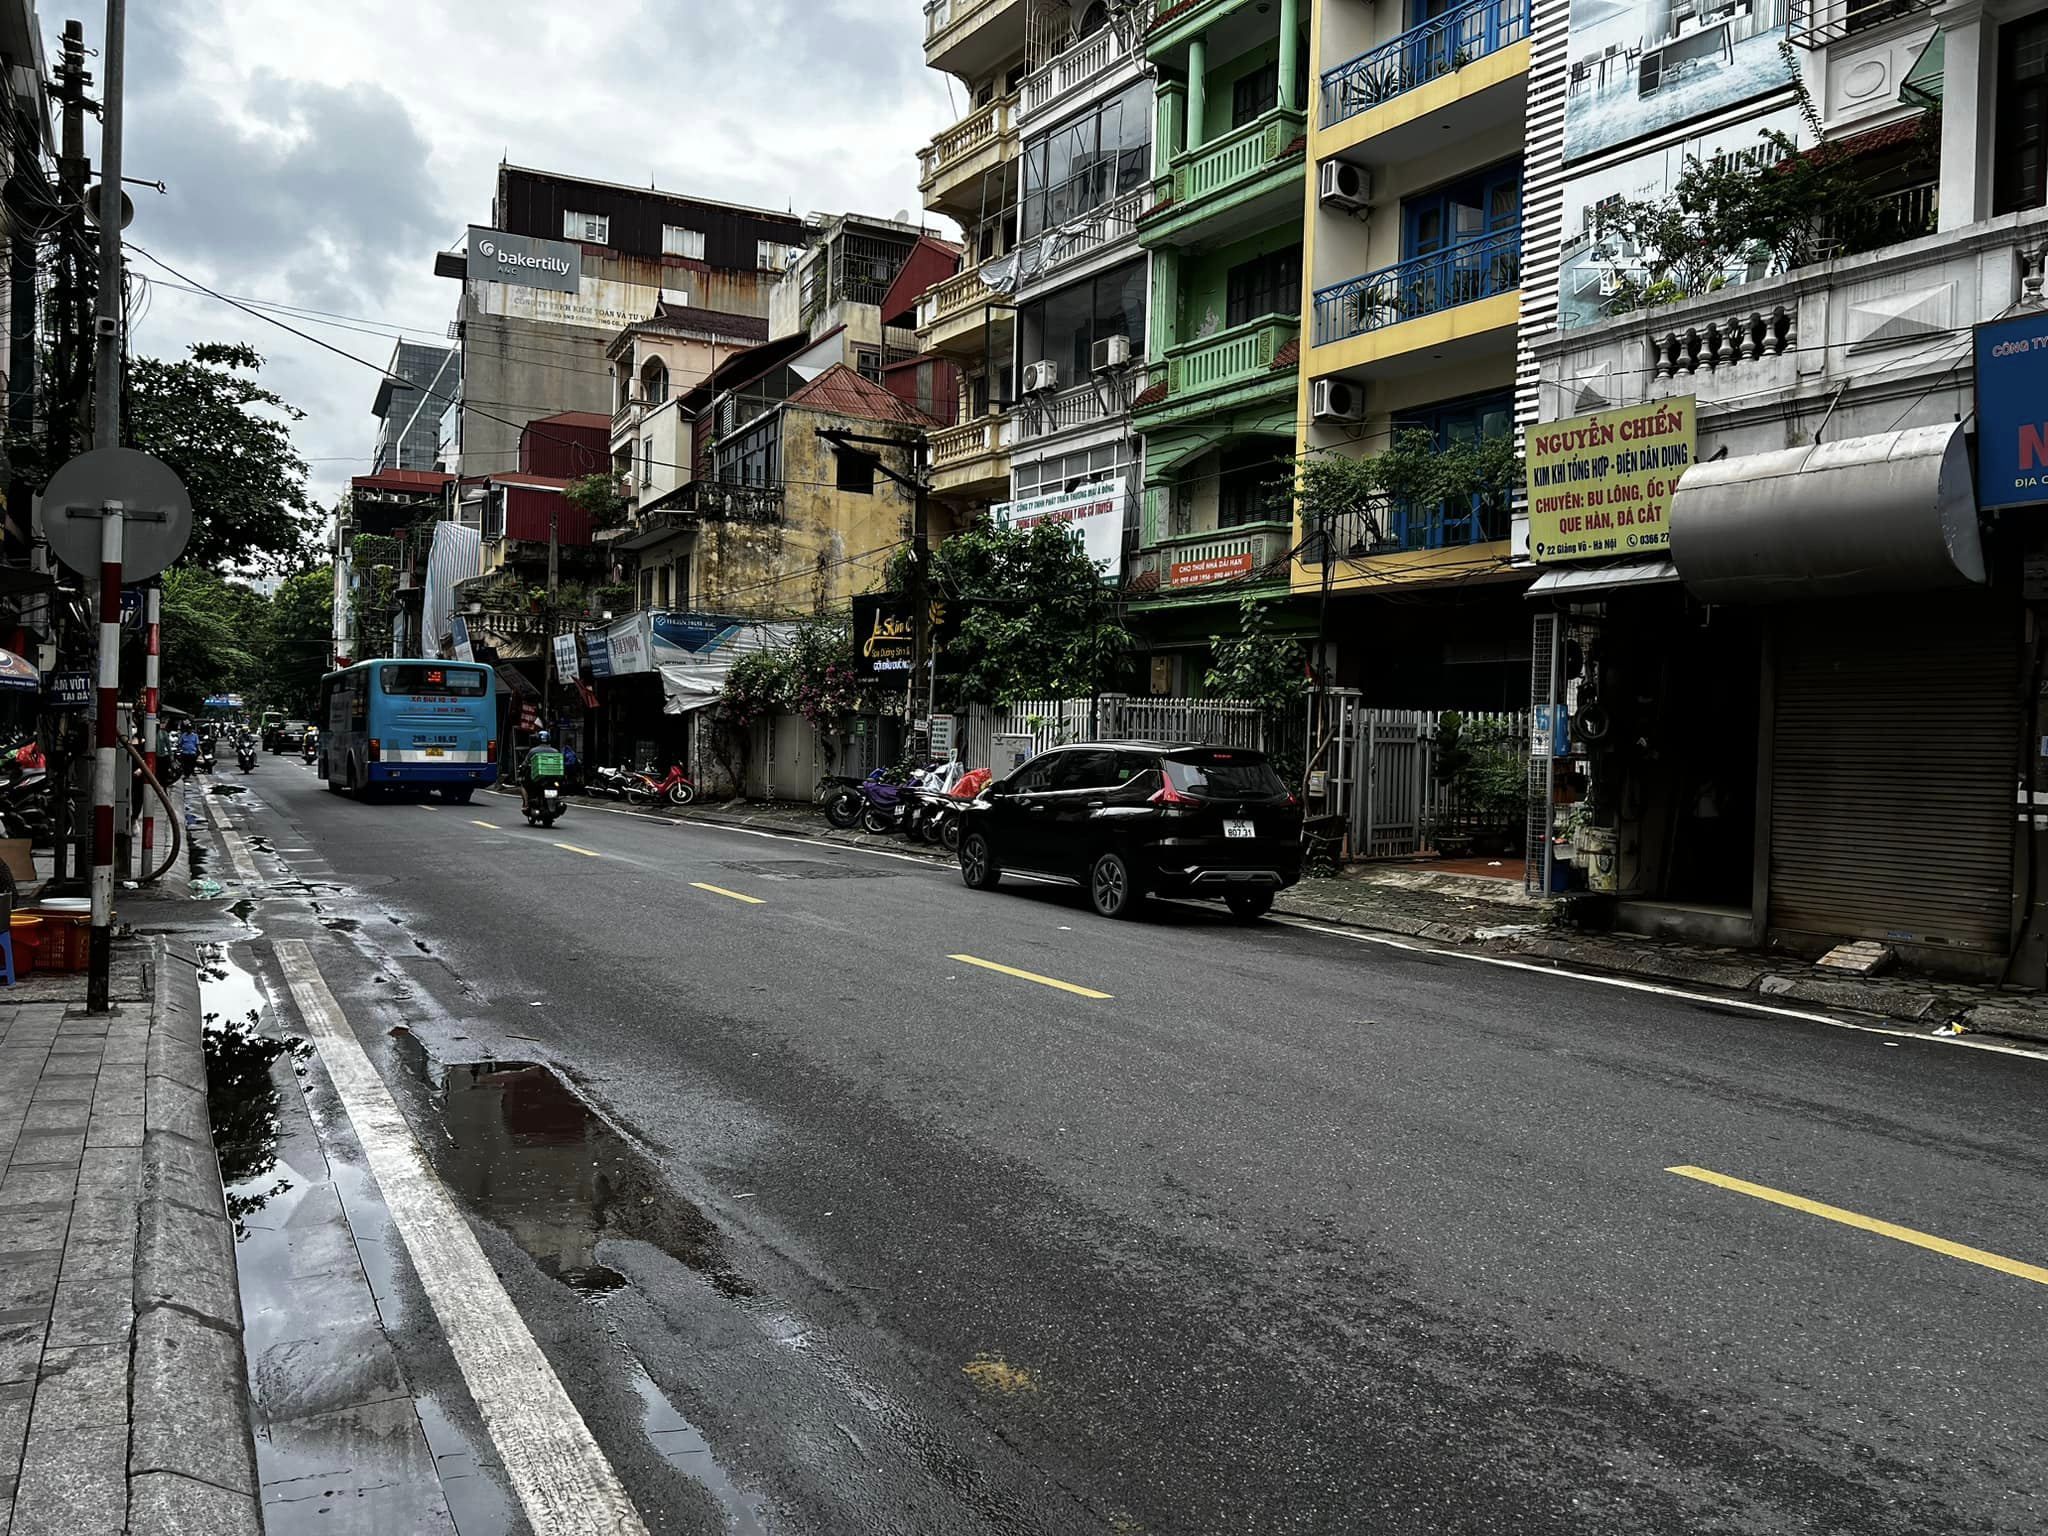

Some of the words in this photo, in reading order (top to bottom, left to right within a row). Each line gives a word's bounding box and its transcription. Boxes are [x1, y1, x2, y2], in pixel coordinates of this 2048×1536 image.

[497, 249, 570, 275] bakertilly
[497, 265, 518, 275] A&C
[1992, 340, 2030, 357] CÔNG
[1535, 416, 1615, 457] NGUYỄN
[1619, 404, 1683, 441] CHIẾN
[1533, 463, 1550, 487] KIM
[1551, 459, 1566, 486] KHÍ
[1568, 453, 1590, 482] TỔNG
[1592, 455, 1609, 482] HỢP
[1616, 449, 1638, 477] ĐIỆN
[1640, 445, 1660, 471] DÂN
[1661, 442, 1688, 472] DỤNG
[1535, 492, 1584, 514] CHUYÊN:
[1587, 490, 1604, 507] BU
[1607, 484, 1643, 504] LÔNG,
[1647, 476, 1665, 499] ỐC
[2015, 477, 2038, 488] ĐỊA
[1559, 515, 1582, 535] QUE
[1585, 511, 1614, 530] HÀN,
[1617, 507, 1634, 526] ĐÁ
[1638, 502, 1662, 524] CẮT
[1547, 545, 1556, 555] 22
[1557, 542, 1577, 556] Giảng
[1578, 541, 1587, 552] Võ
[1593, 539, 1603, 550] Hà
[1604, 538, 1617, 552] Nội
